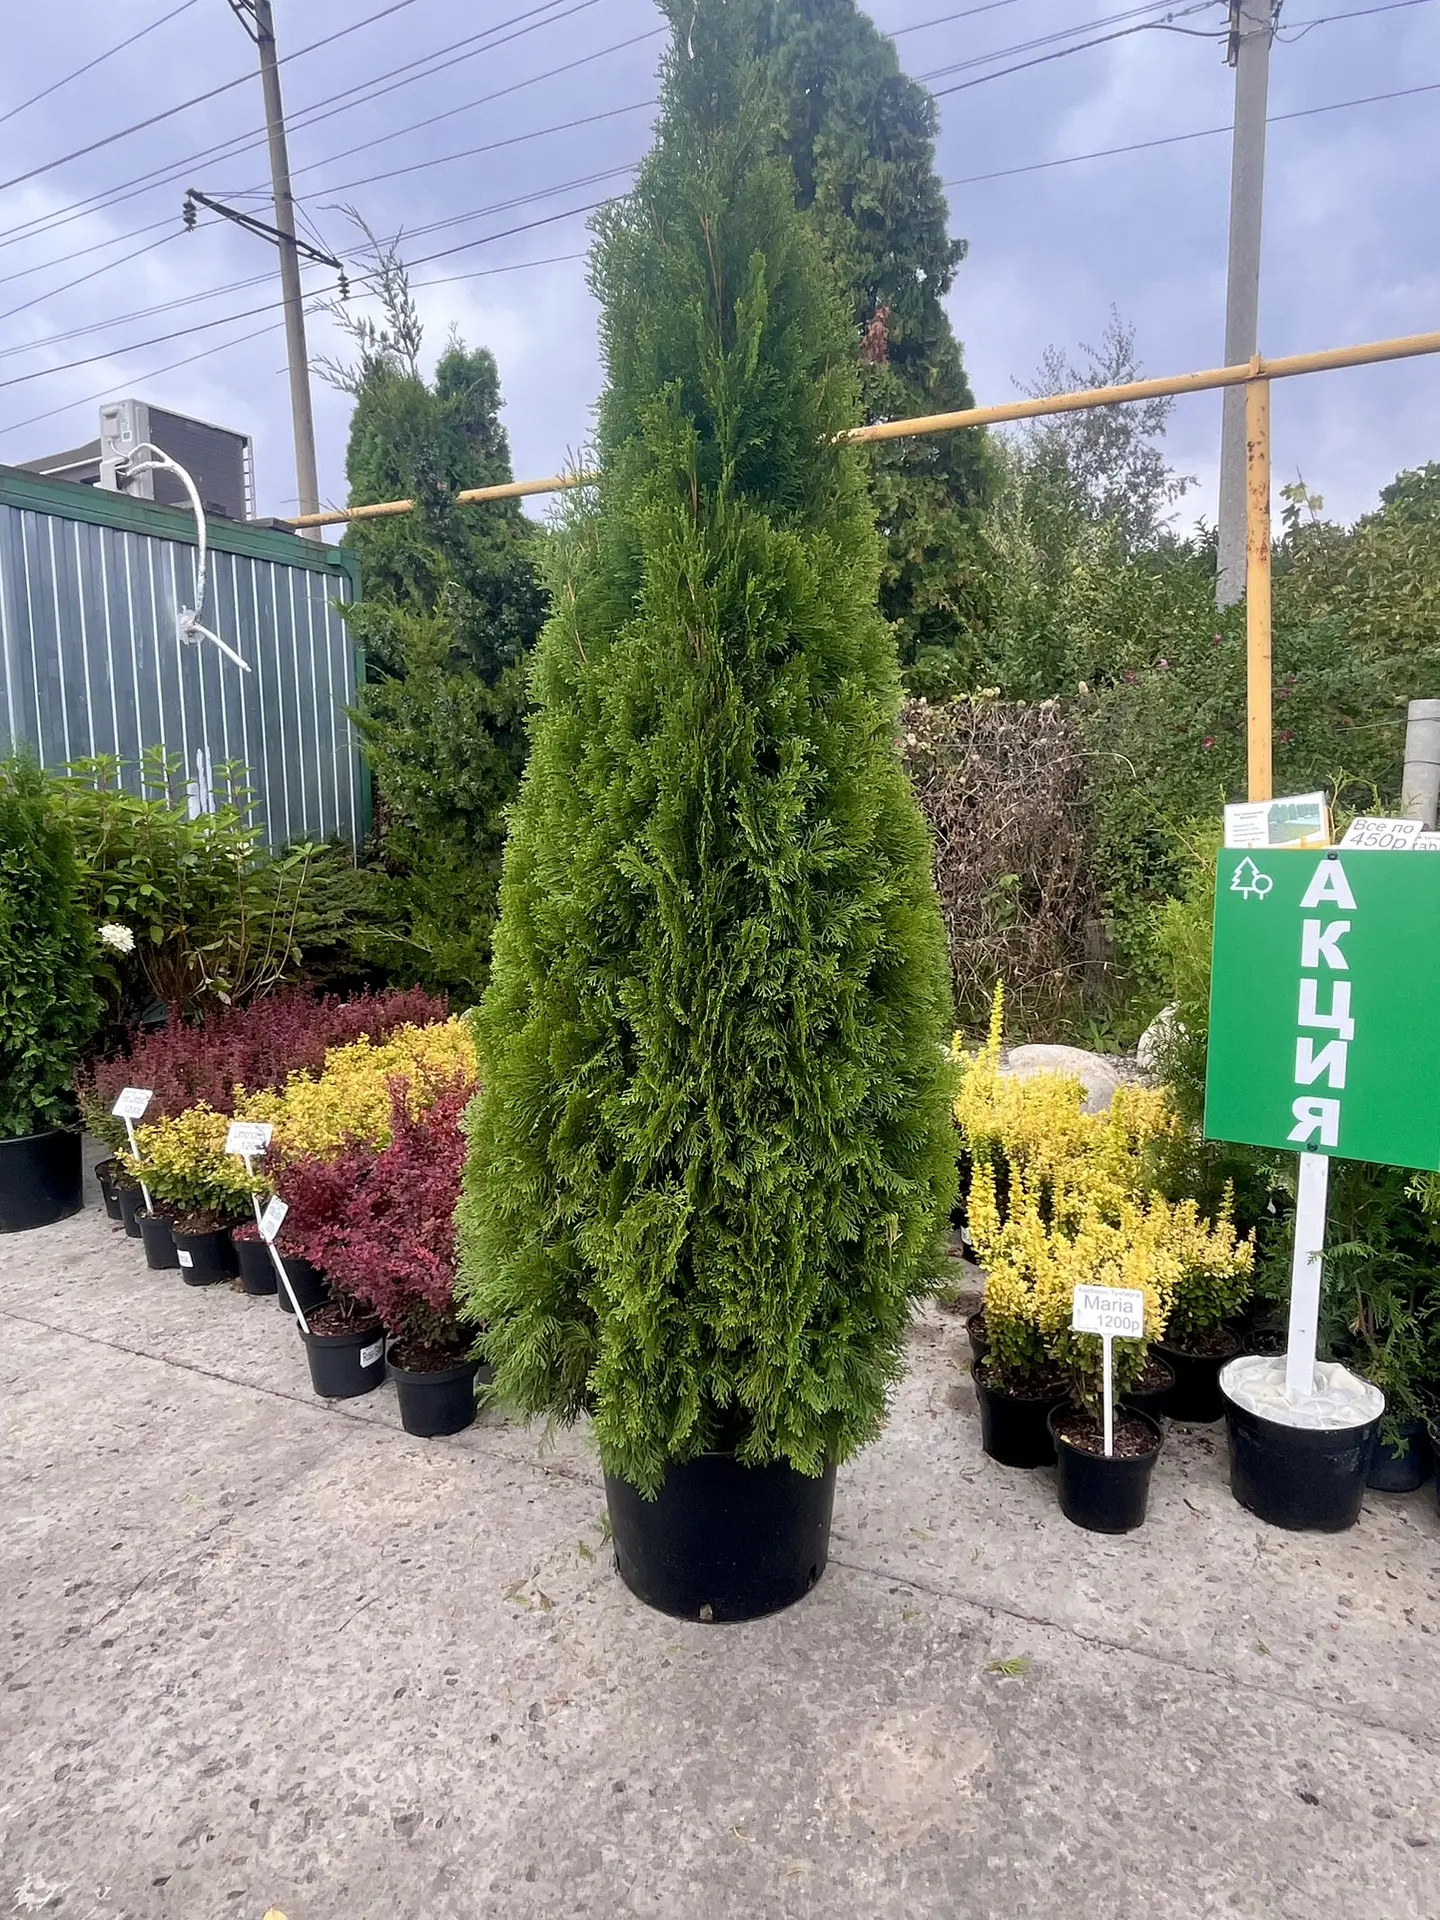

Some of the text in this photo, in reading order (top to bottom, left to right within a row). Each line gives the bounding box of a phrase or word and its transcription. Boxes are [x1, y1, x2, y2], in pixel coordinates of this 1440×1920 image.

[1353, 819, 1414, 834] Все по
[1349, 832, 1407, 850] 450р
[1287, 859, 1357, 1147] АКЦИЯ
[1083, 1294, 1134, 1314] Maria
[1097, 1315, 1140, 1333] 1200р
